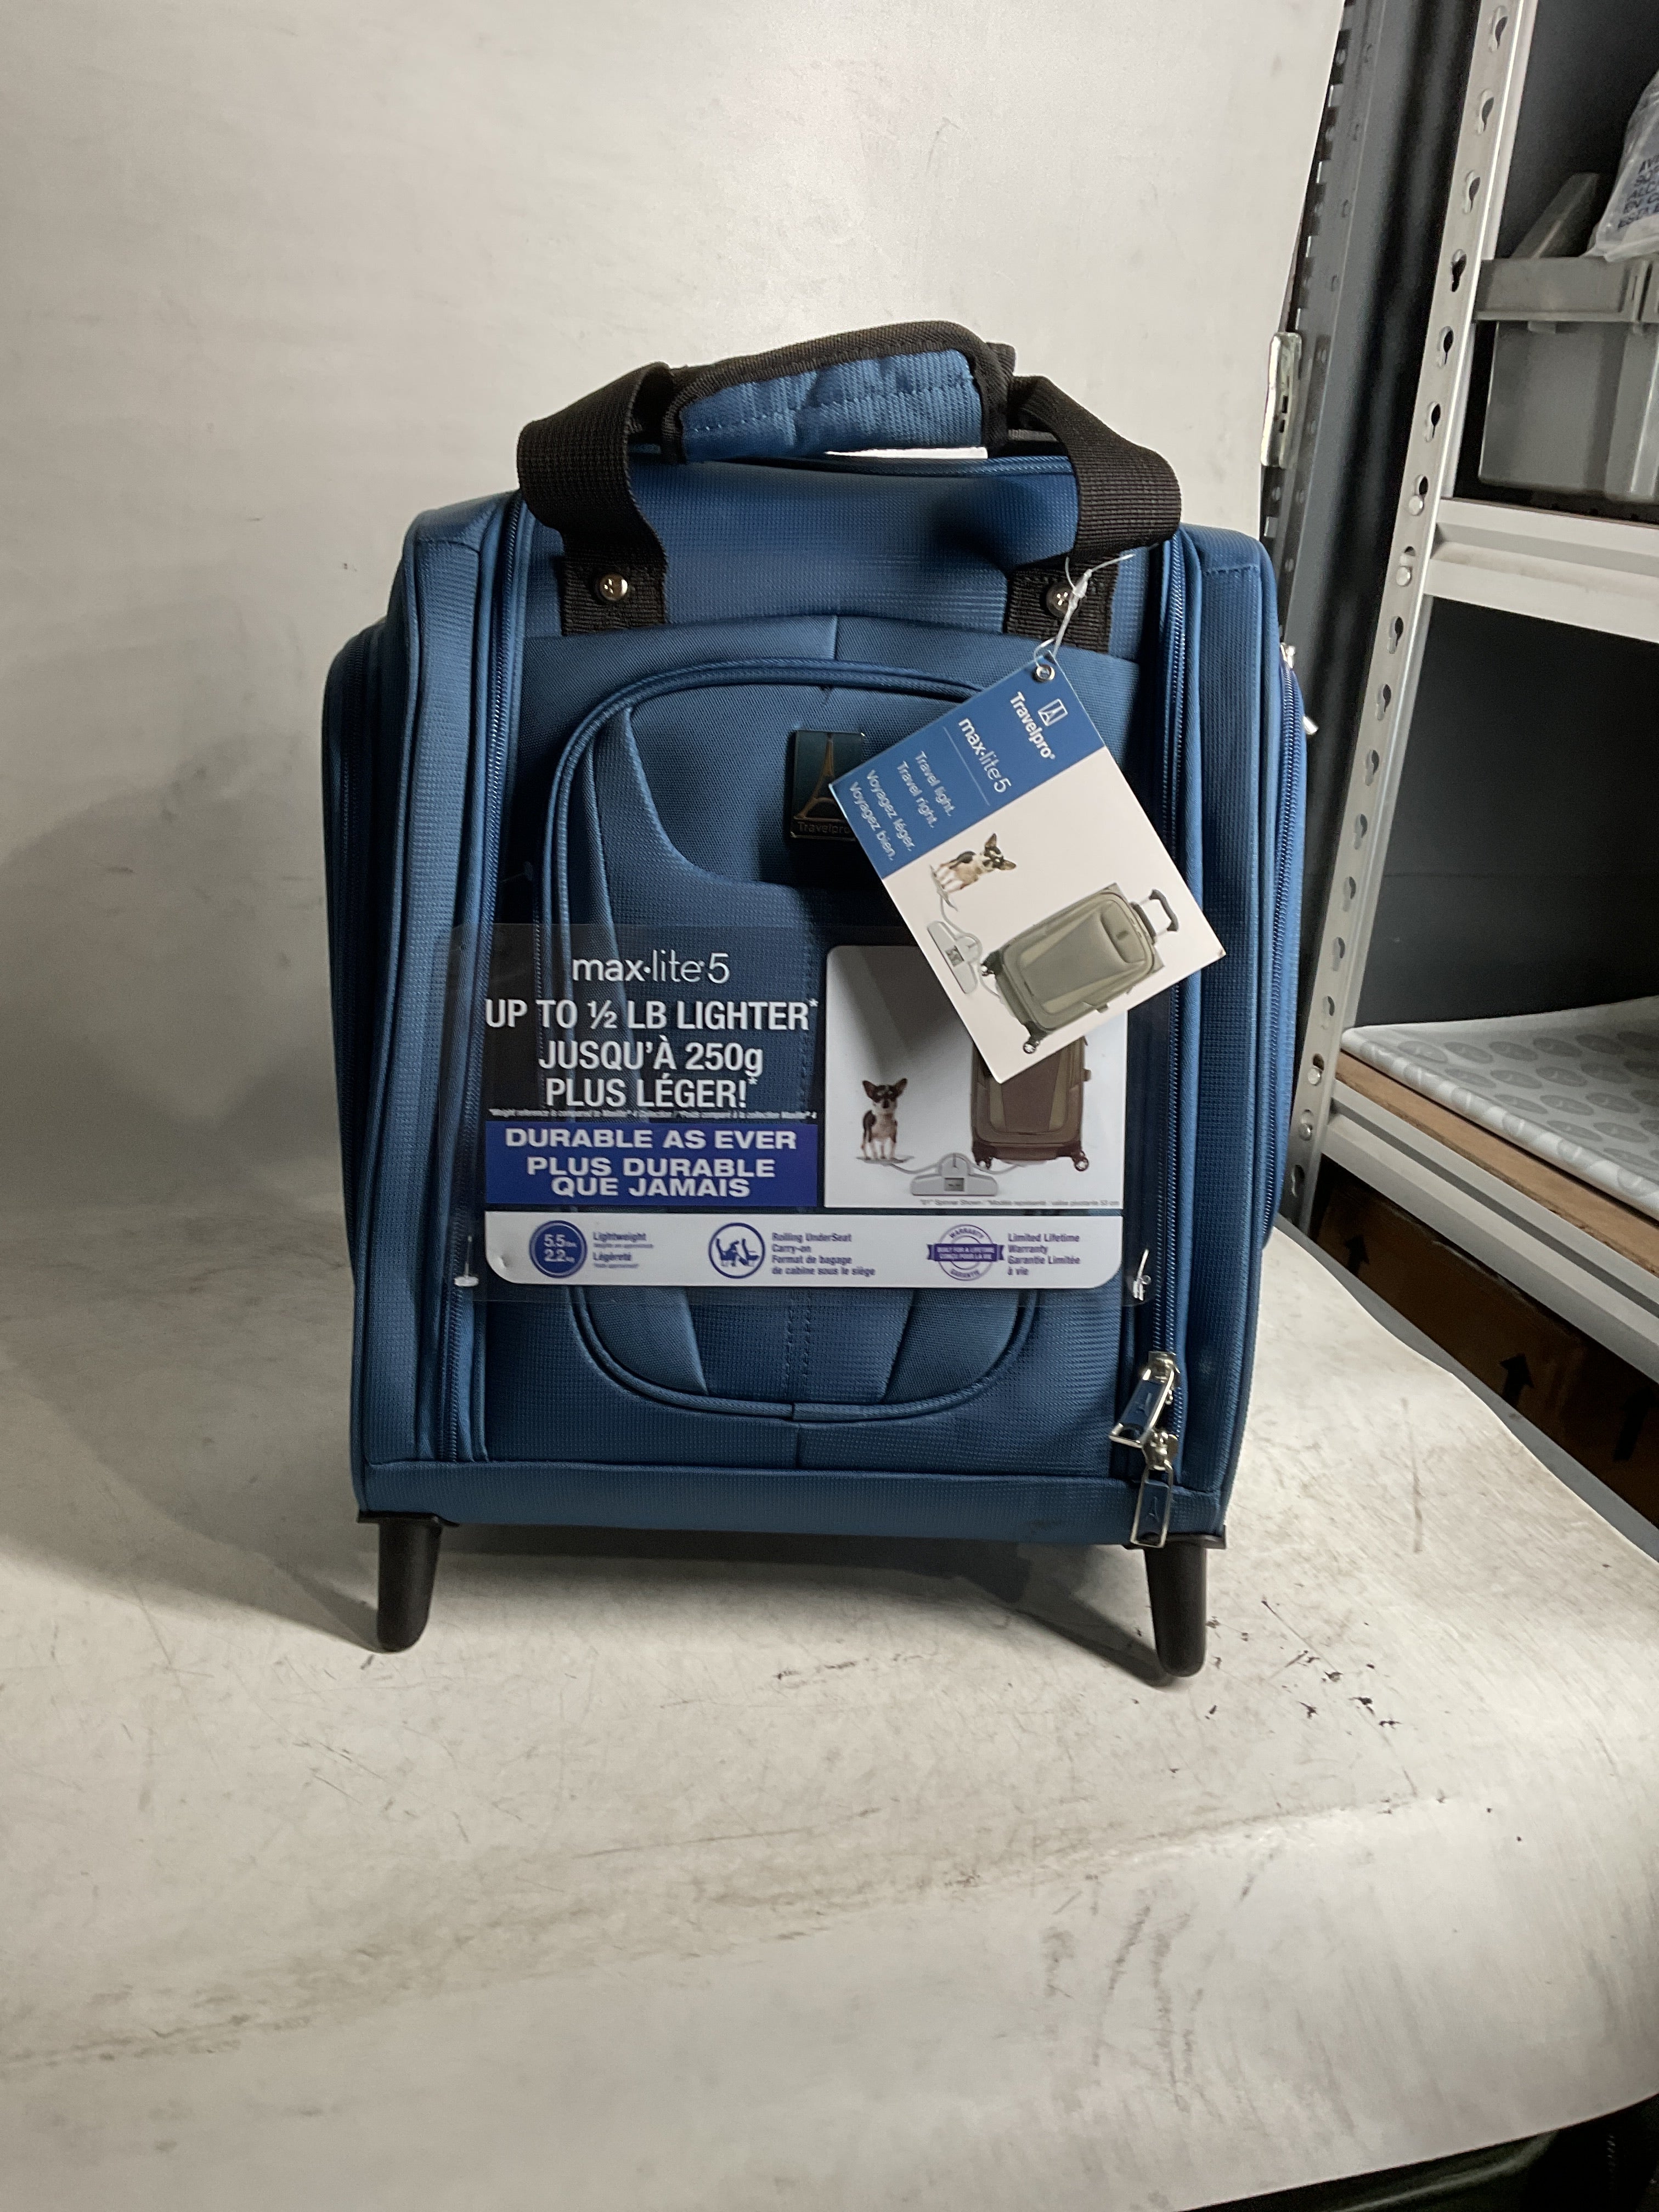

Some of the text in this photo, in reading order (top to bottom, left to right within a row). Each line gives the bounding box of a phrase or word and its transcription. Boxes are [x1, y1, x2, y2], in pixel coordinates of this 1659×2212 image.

[898, 760, 938, 828] Travel right.
[915, 751, 956, 817] Travel light.
[850, 781, 896, 861] Voyagez bien.
[867, 770, 916, 851] Voyagez léger.
[485, 998, 528, 1028] UP
[535, 998, 578, 1029] TO
[627, 1000, 667, 1030] LB
[538, 1035, 764, 1077] JUSQU'À 250g
[546, 1077, 627, 1108] PLUS
[506, 1128, 797, 1149] DURABLE AS EVER
[527, 1156, 776, 1178] PLUS DURABLE
[551, 1177, 751, 1198] QUE JAMAIS
[592, 1232, 647, 1243] Lightweight
[772, 1232, 852, 1244] Rolling UnderSeat
[1007, 1233, 1080, 1243] Limited Lifetime
[772, 1243, 812, 1254] Carry-on
[1008, 1244, 1048, 1255] Warranty
[772, 1255, 852, 1266] Format de bagage
[1007, 1255, 1081, 1265] Garantie Limitée
[1007, 1265, 1030, 1276] à vie
[771, 1266, 876, 1277] de cabine sous le siège
